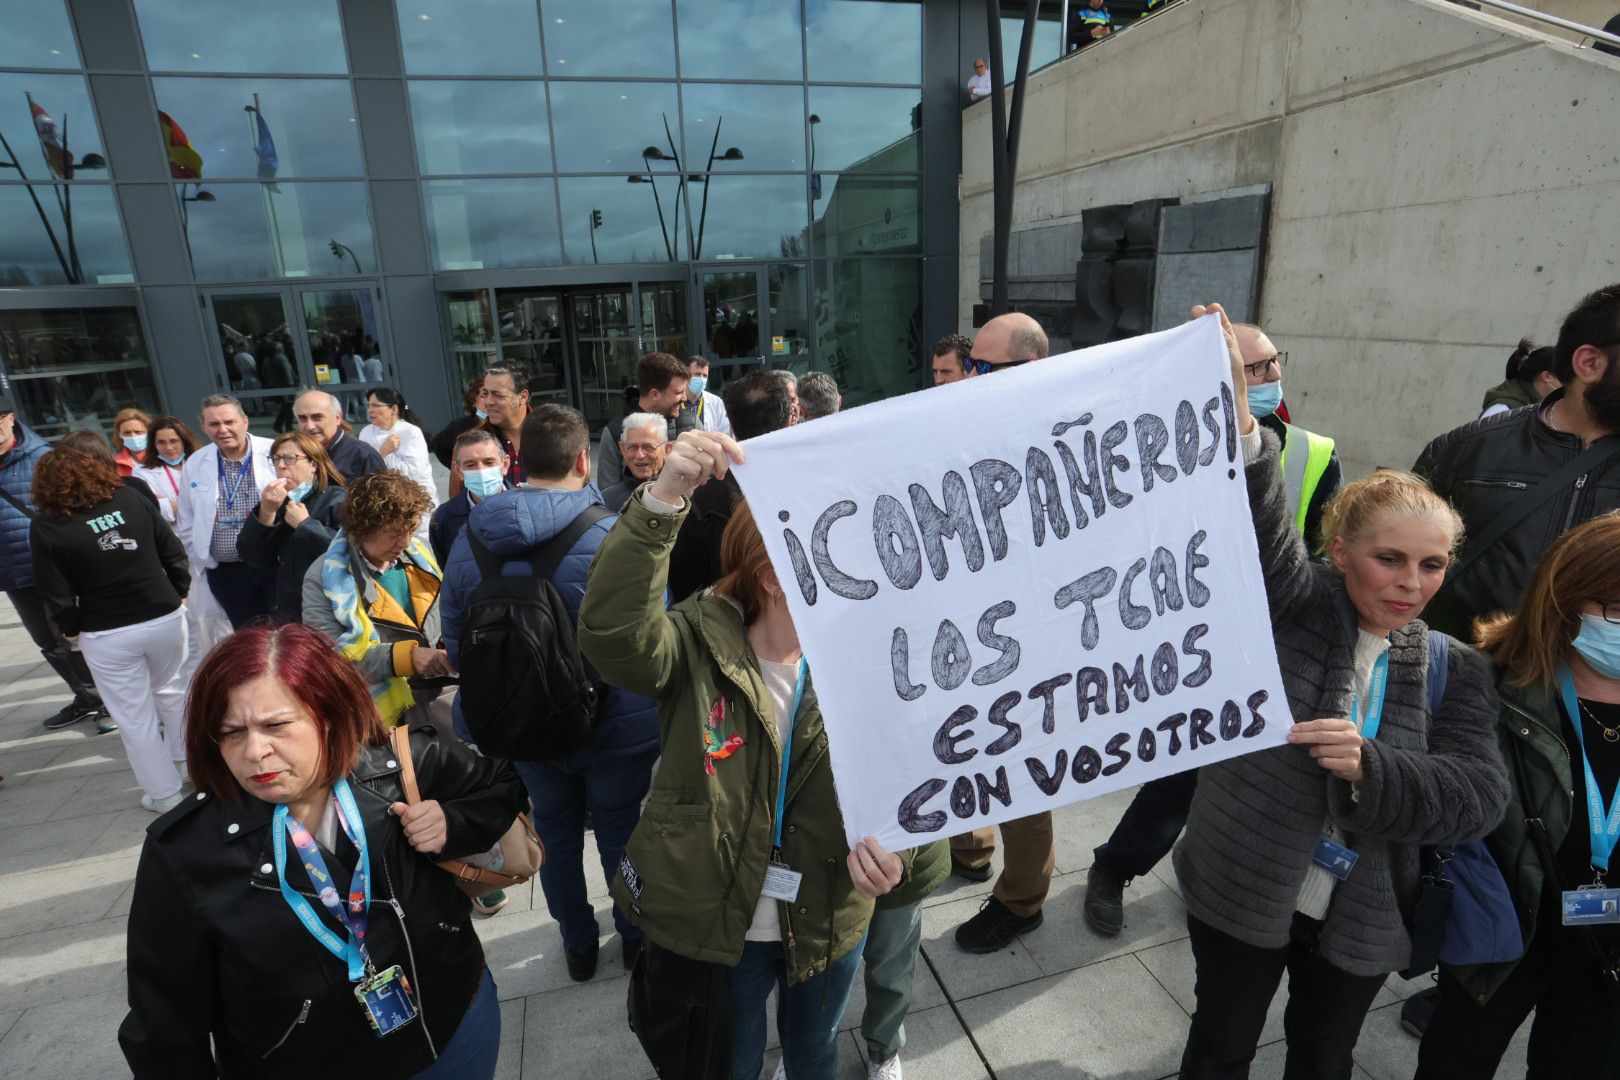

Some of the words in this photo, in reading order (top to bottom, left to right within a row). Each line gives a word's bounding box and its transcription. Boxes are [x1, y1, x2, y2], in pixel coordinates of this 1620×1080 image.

[86, 510, 126, 534] TERT
[778, 381, 1237, 606] ¡COMPAÑEROS!
[891, 600, 1021, 701] LOS
[1054, 529, 1211, 651] TCAE
[898, 765, 1012, 833] CON
[1025, 690, 1269, 796] VOSOTROS
[933, 624, 1212, 765] ESTAMOS
